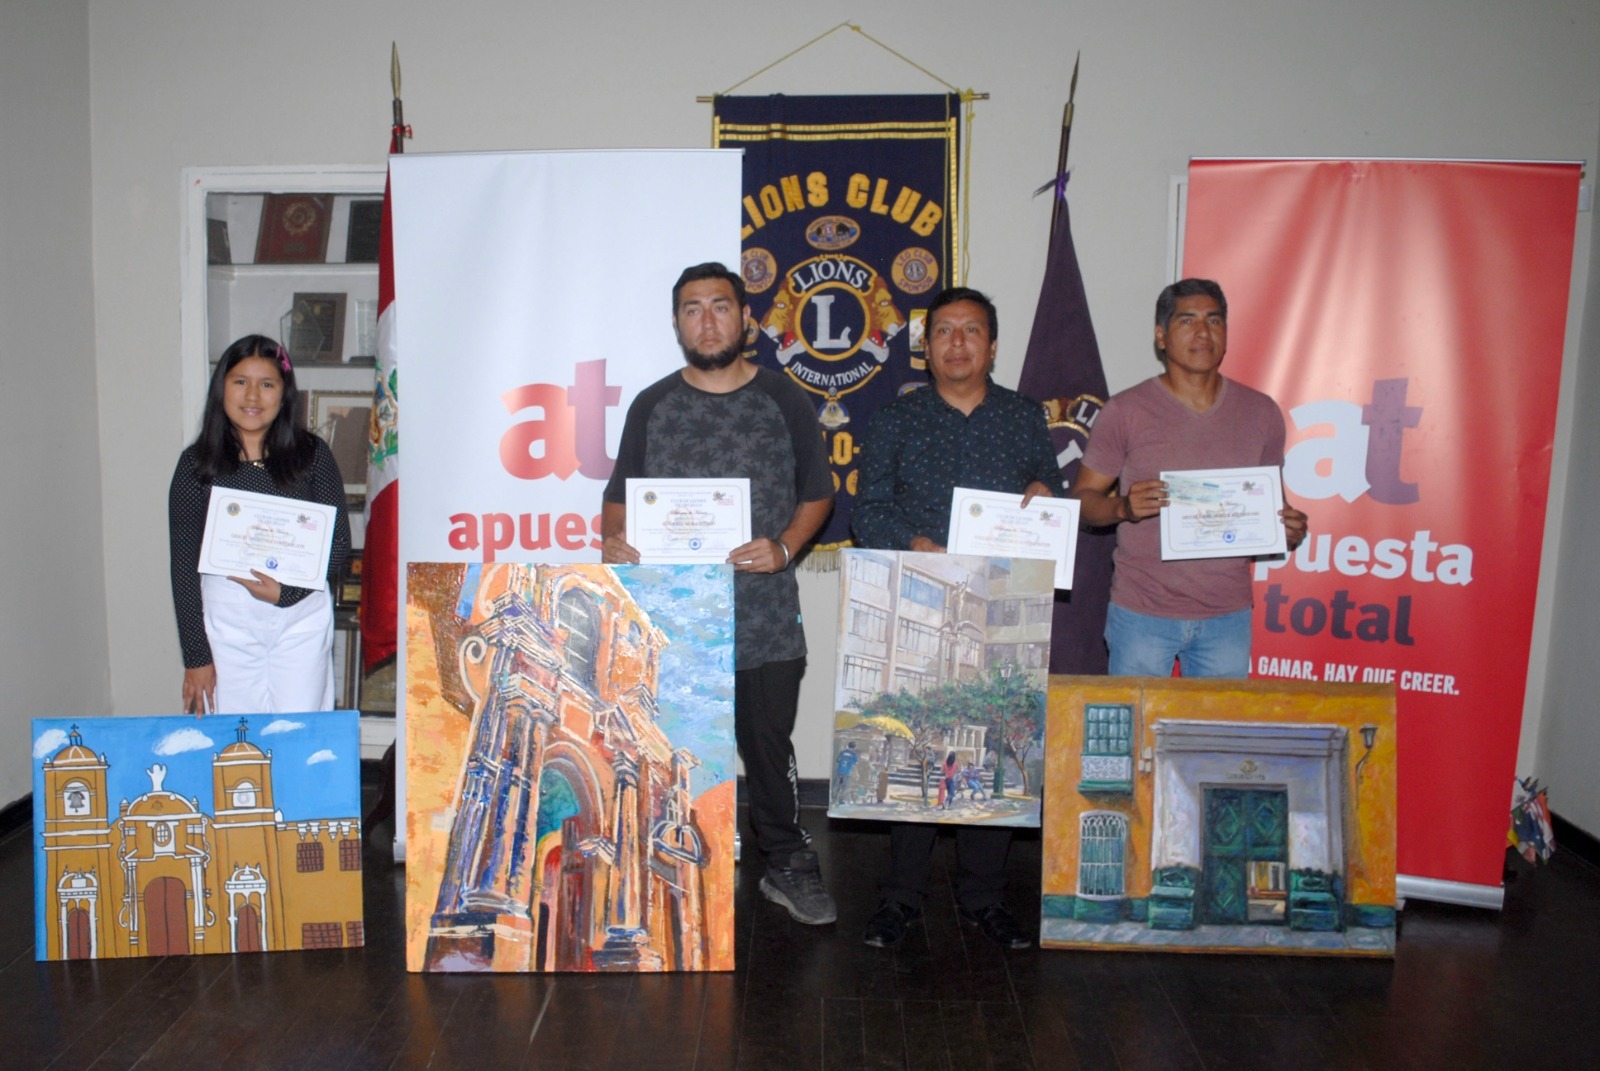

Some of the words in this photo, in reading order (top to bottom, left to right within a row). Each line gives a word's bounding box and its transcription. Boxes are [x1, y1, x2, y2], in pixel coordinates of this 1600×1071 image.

[846, 173, 943, 237] CLUB
[792, 260, 868, 290] LIONS
[811, 295, 851, 349] L
[790, 361, 874, 386] INTERNATIONAL
[499, 358, 623, 481] at
[1282, 377, 1424, 505] at
[1264, 584, 1415, 646] total
[1258, 656, 1318, 681] GANAR,
[1323, 663, 1358, 682] HAY
[1401, 670, 1460, 695] CREER.
